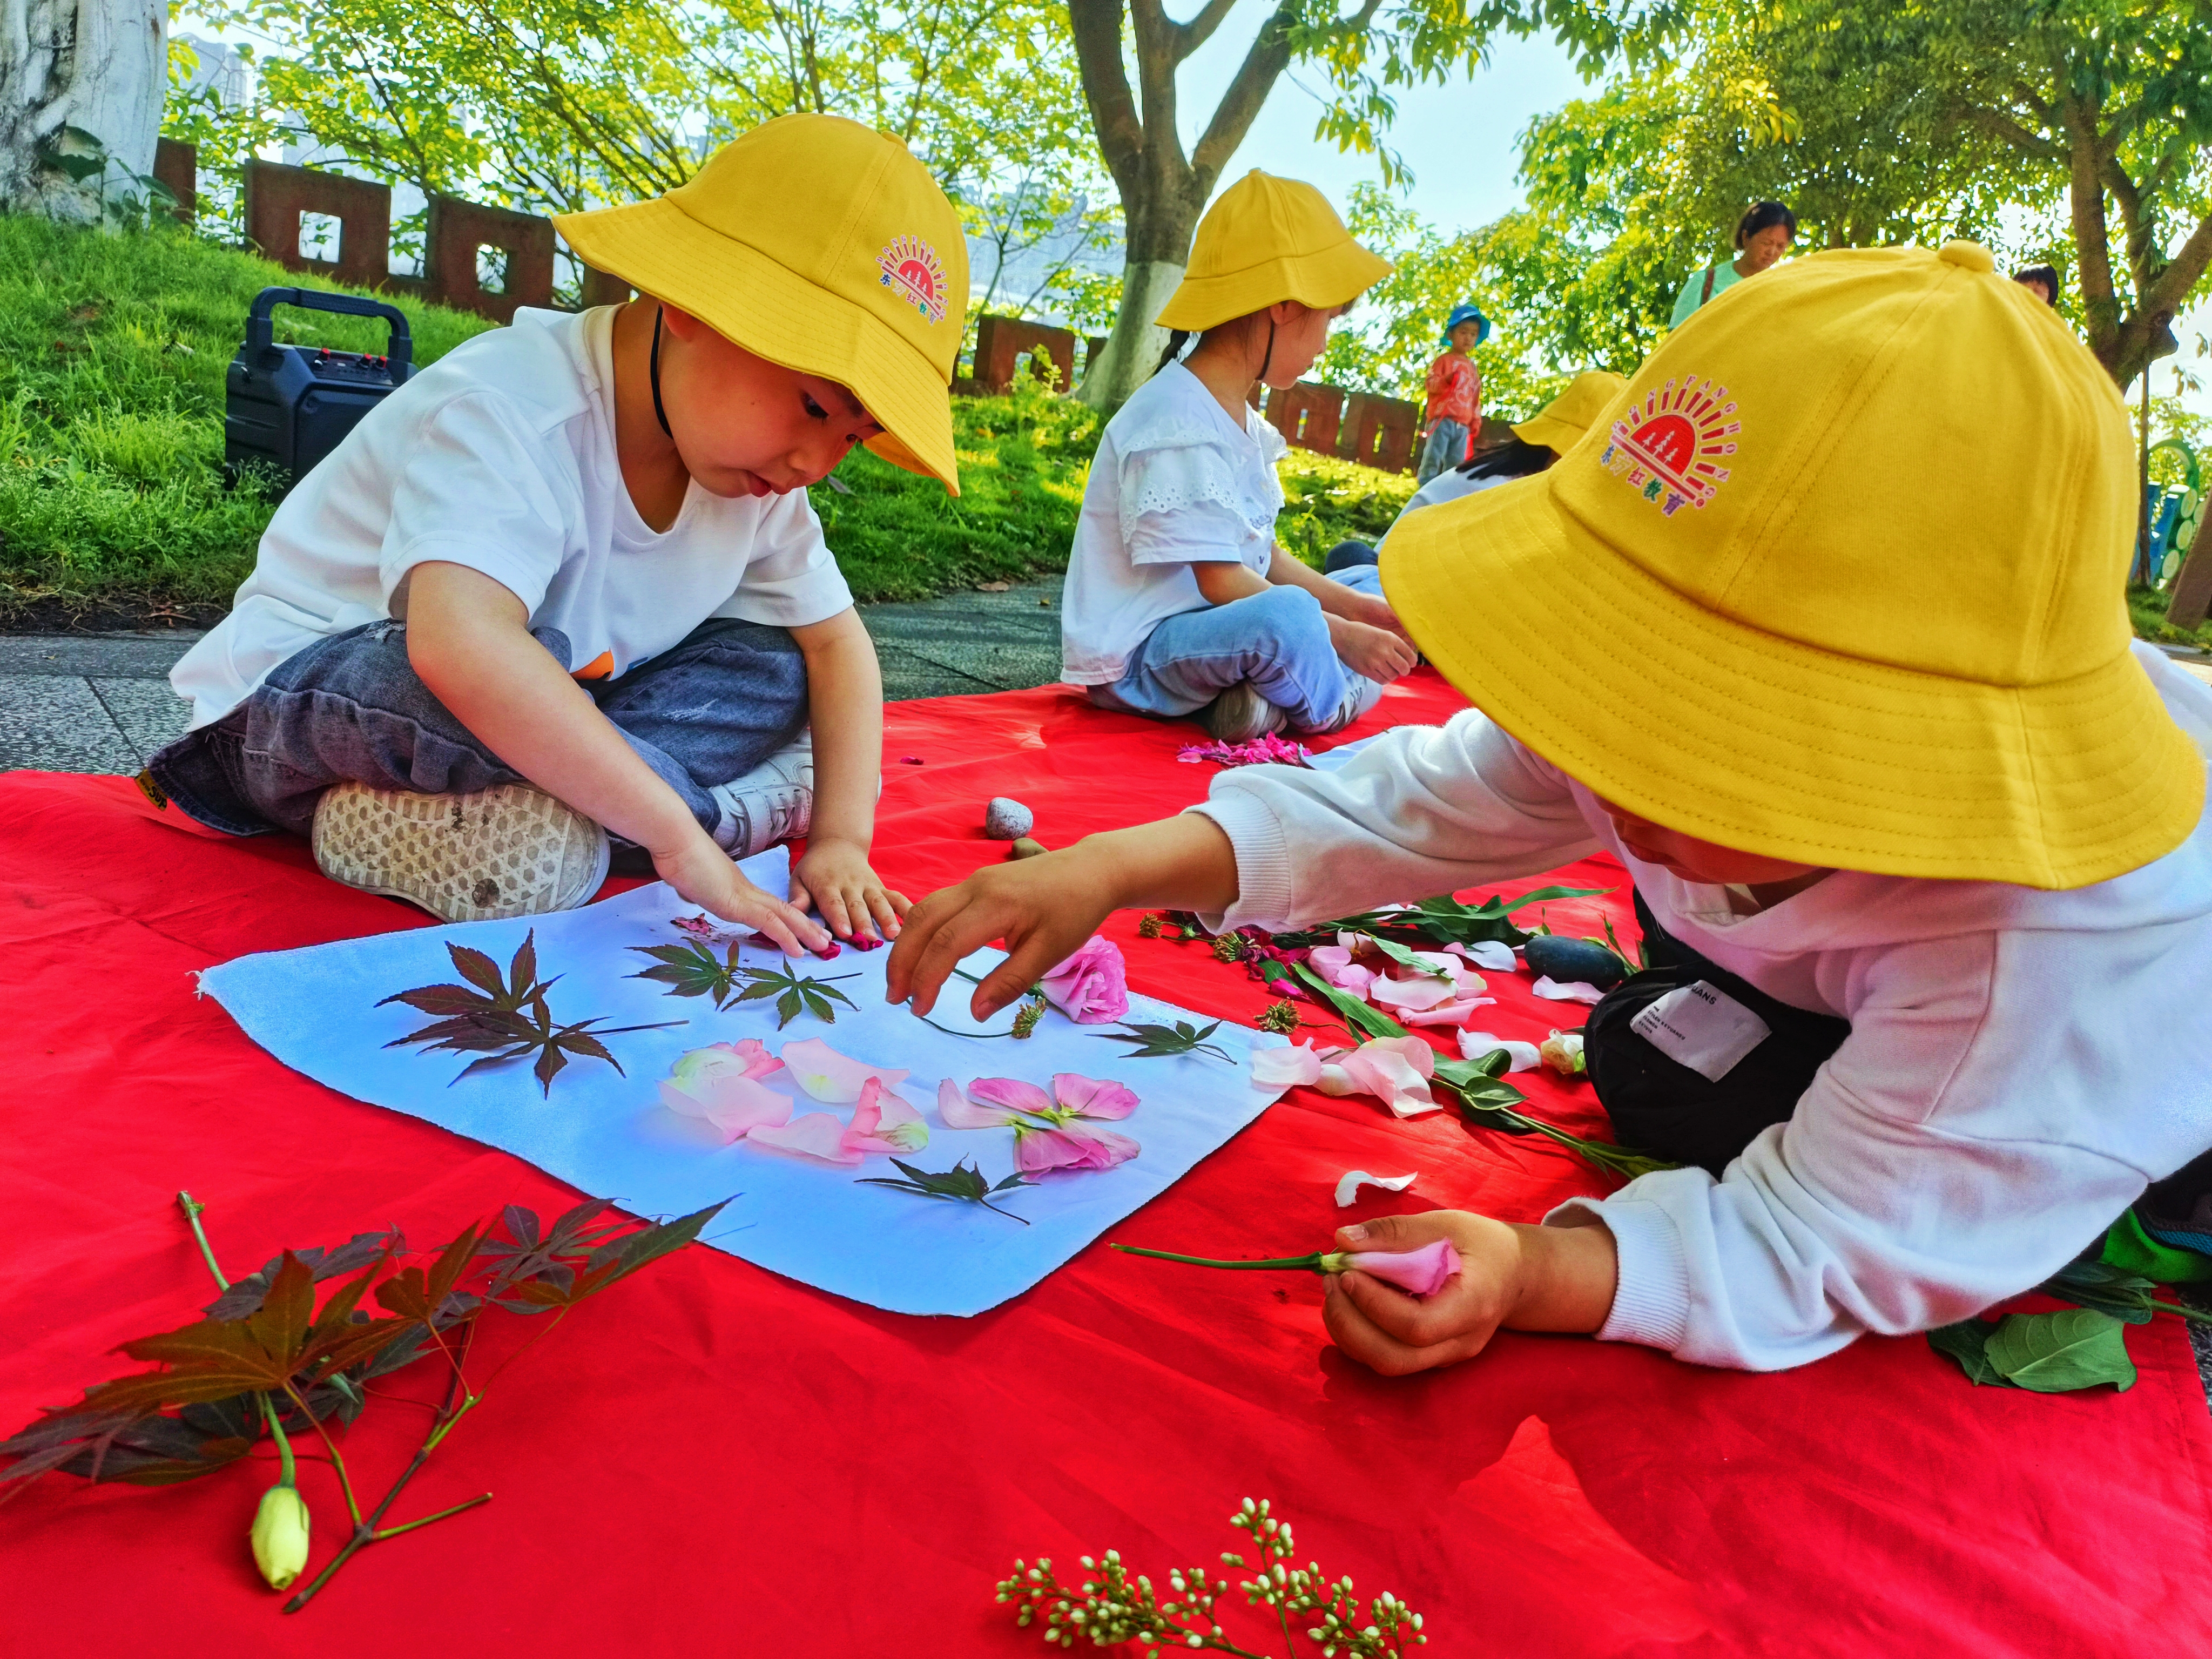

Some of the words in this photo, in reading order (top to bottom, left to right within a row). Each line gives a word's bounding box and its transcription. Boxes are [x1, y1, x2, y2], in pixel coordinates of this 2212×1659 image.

[880, 273, 936, 325] 东方红教育
[1601, 444, 1685, 517] 东方红教育
